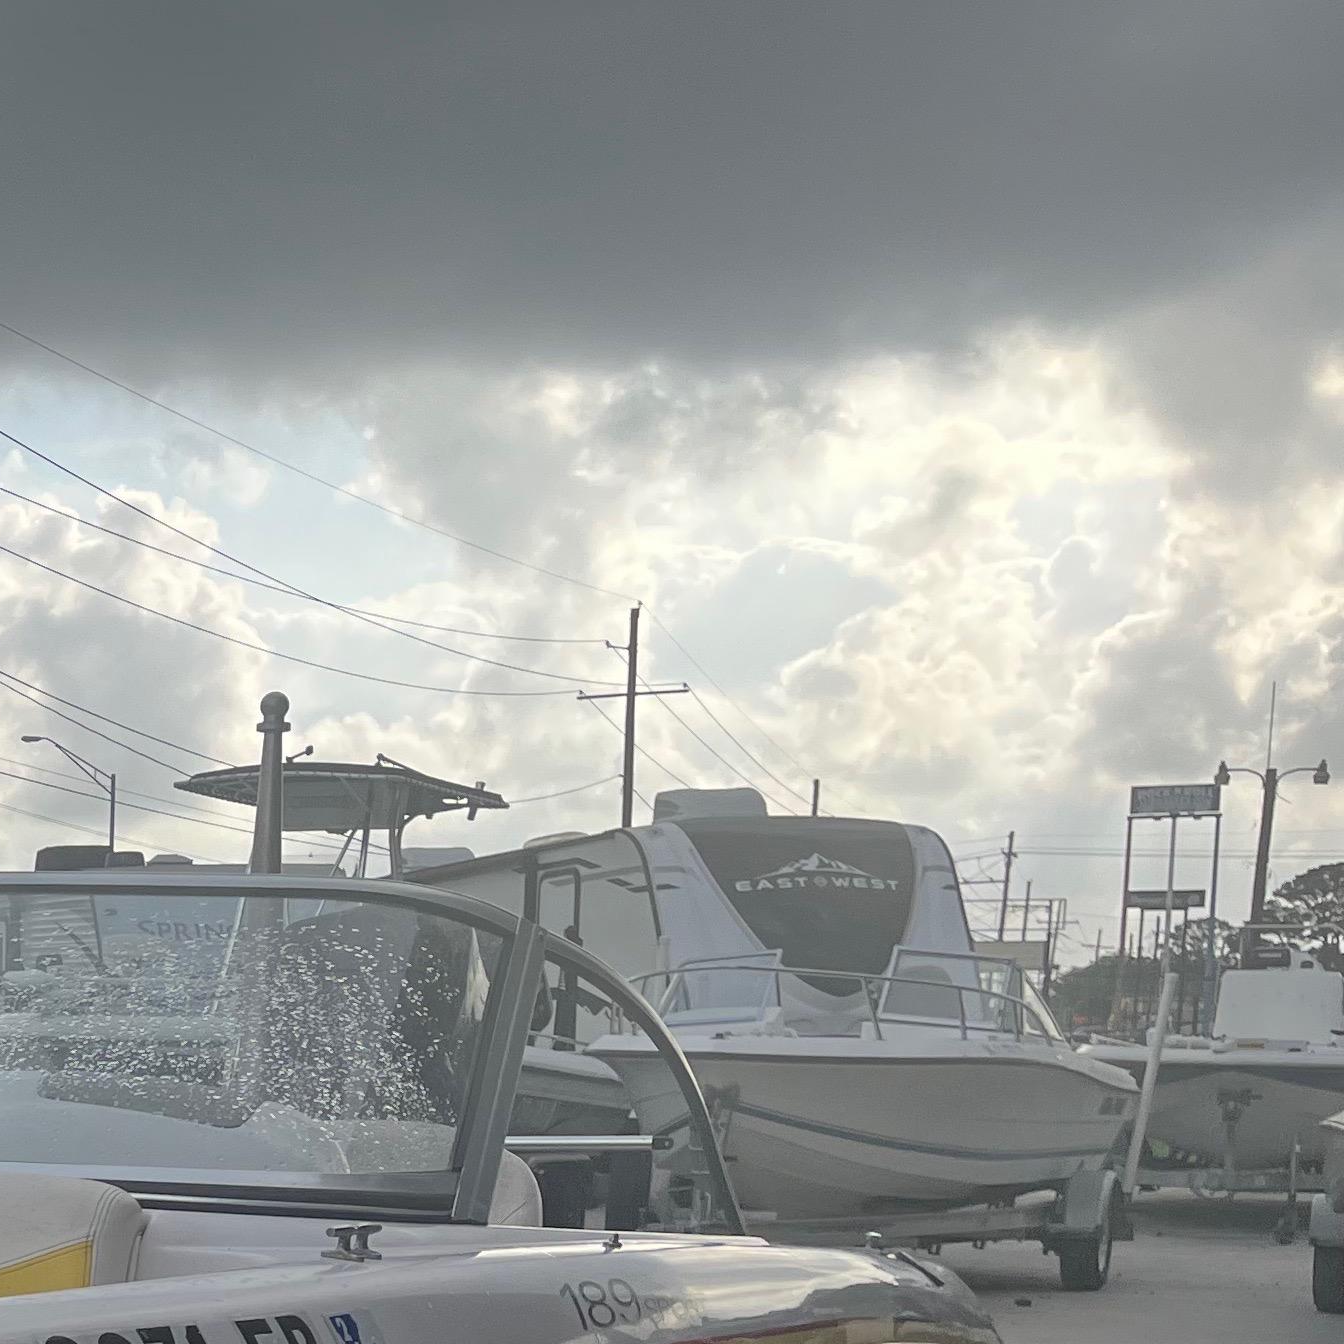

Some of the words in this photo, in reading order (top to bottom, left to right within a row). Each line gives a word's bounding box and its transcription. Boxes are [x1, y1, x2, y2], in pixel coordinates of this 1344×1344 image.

[735, 876, 808, 892] EAST
[831, 876, 899, 891] WEST
[138, 919, 234, 941] SPRIN
[559, 1278, 642, 1331] 189
